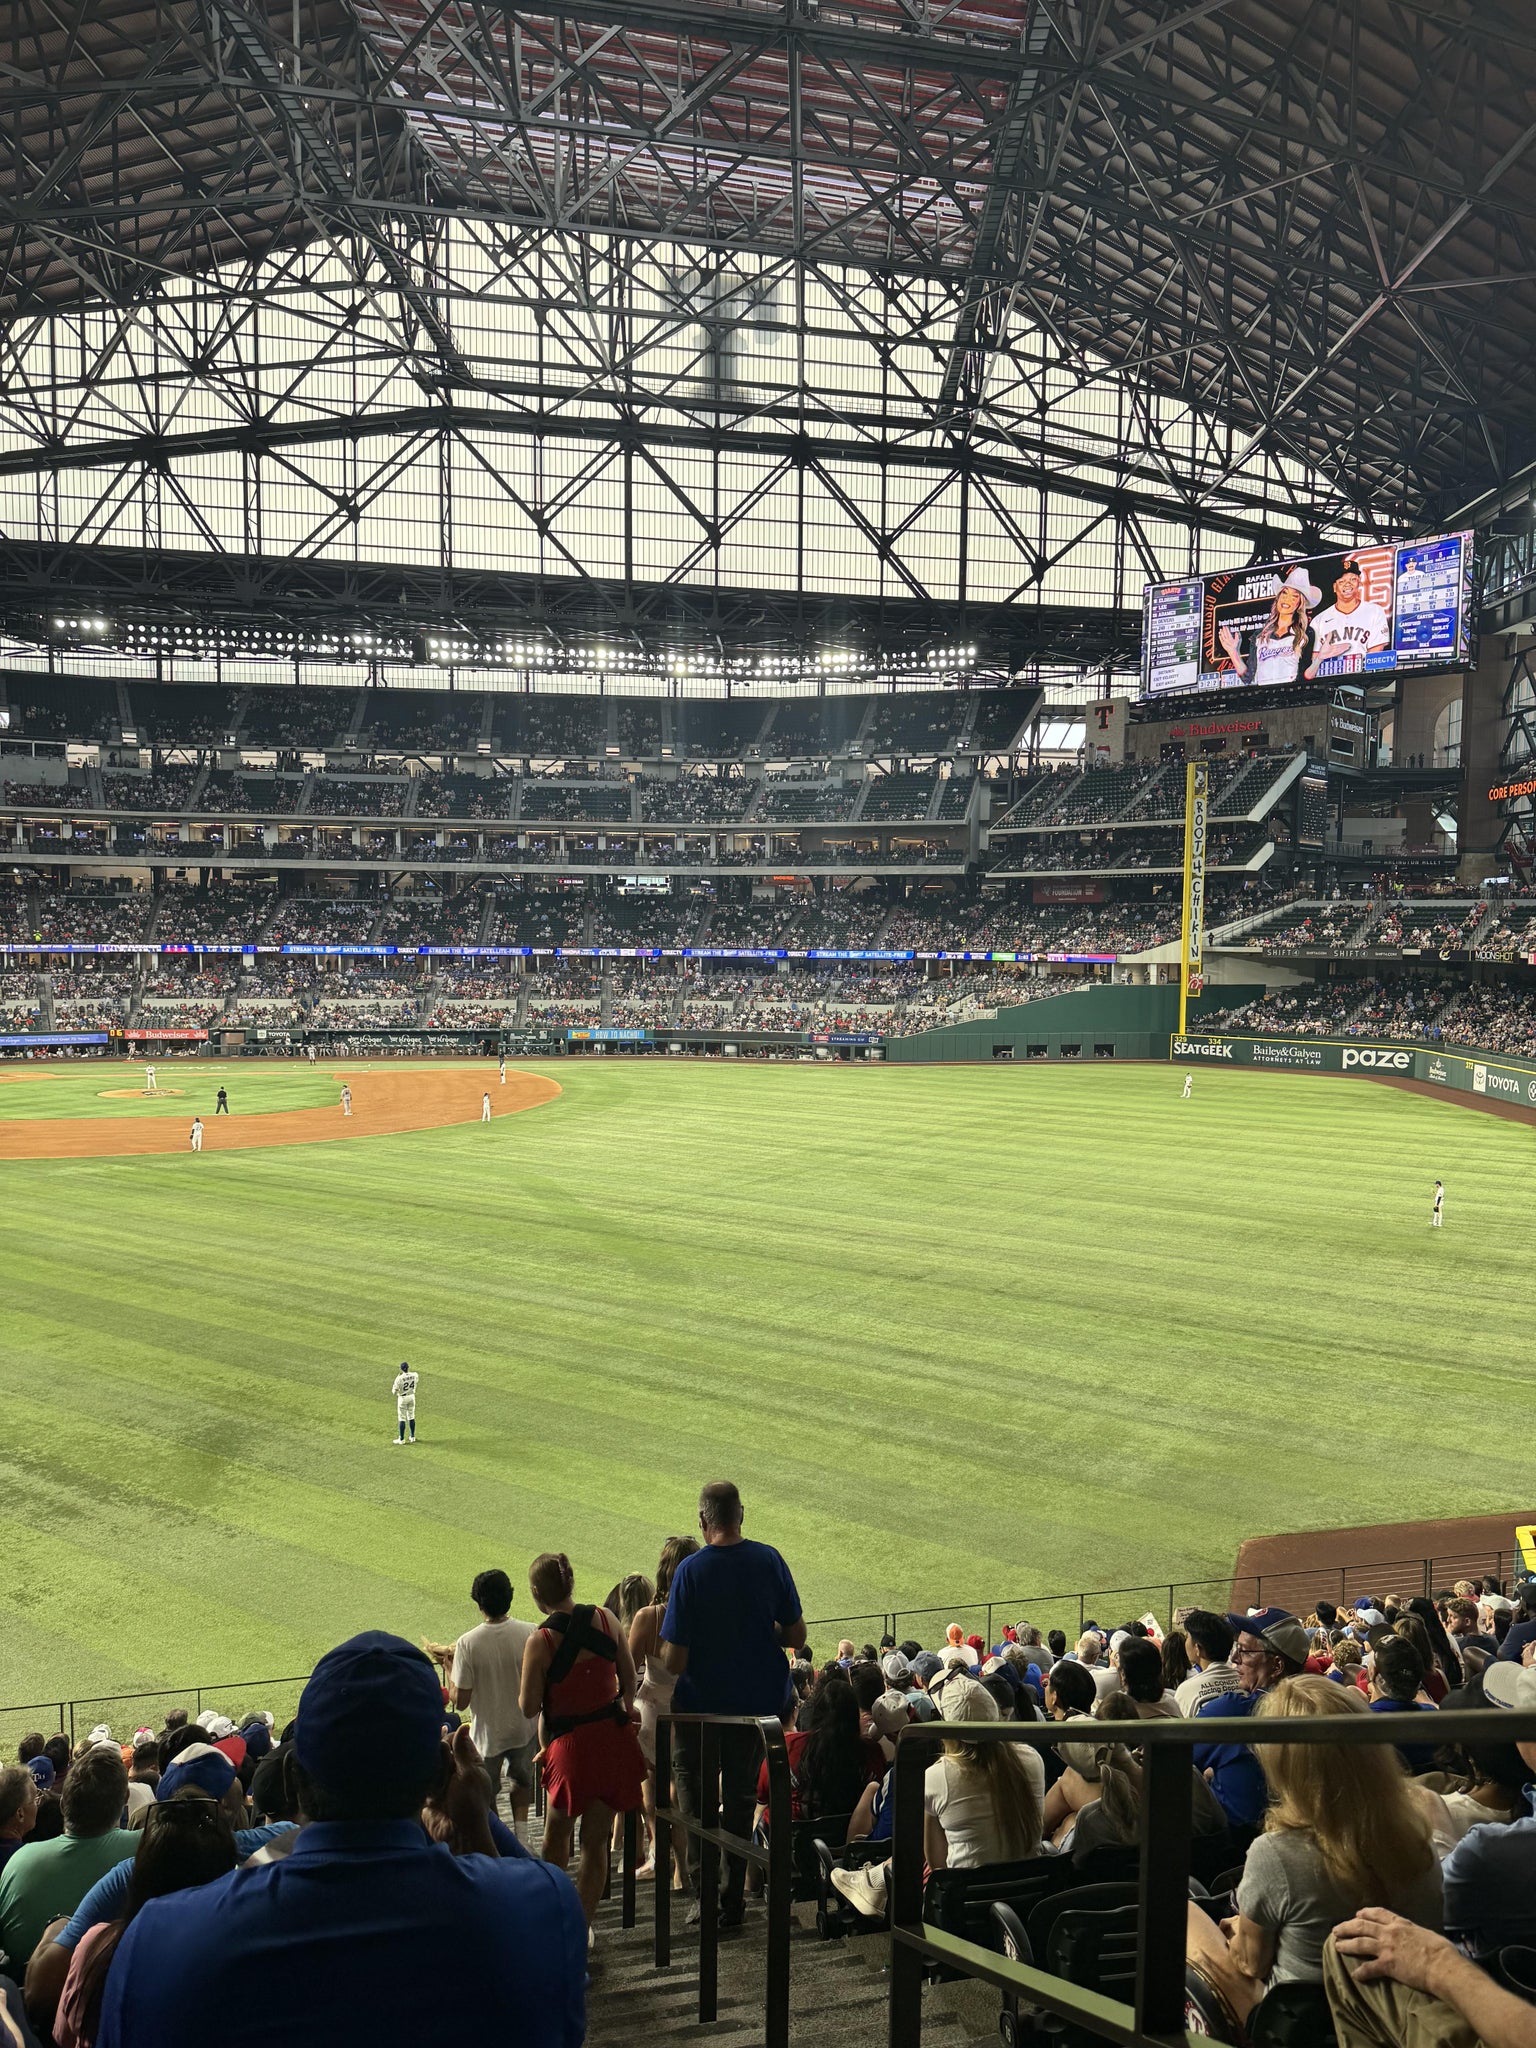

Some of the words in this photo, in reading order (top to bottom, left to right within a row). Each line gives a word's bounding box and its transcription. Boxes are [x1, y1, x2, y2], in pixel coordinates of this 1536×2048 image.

[1246, 574, 1273, 583] RAFAEL
[1238, 580, 1274, 600] DEVER
[1320, 626, 1370, 645] ANTS
[1366, 656, 1396, 665] DIRECTV
[1095, 705, 1114, 730] T
[1190, 720, 1262, 737] Budweiser
[1340, 718, 1364, 734] Budweiser
[1488, 786, 1508, 800] CORE
[1194, 801, 1204, 852] ROOT
[1475, 950, 1514, 960] MOONSHOT
[146, 1031, 189, 1039] Budweiser
[360, 1035, 382, 1044] Kroger
[399, 1035, 422, 1044] Kroger
[437, 1035, 460, 1044] Kroger
[1174, 1042, 1232, 1058] SEATGEEK
[1253, 1045, 1321, 1058] Bailey&Galyen
[1342, 1049, 1410, 1069] paze
[1488, 1075, 1520, 1093] TOYOTA
[403, 1381, 415, 1391] 24
[1199, 1688, 1222, 1698] Racing
